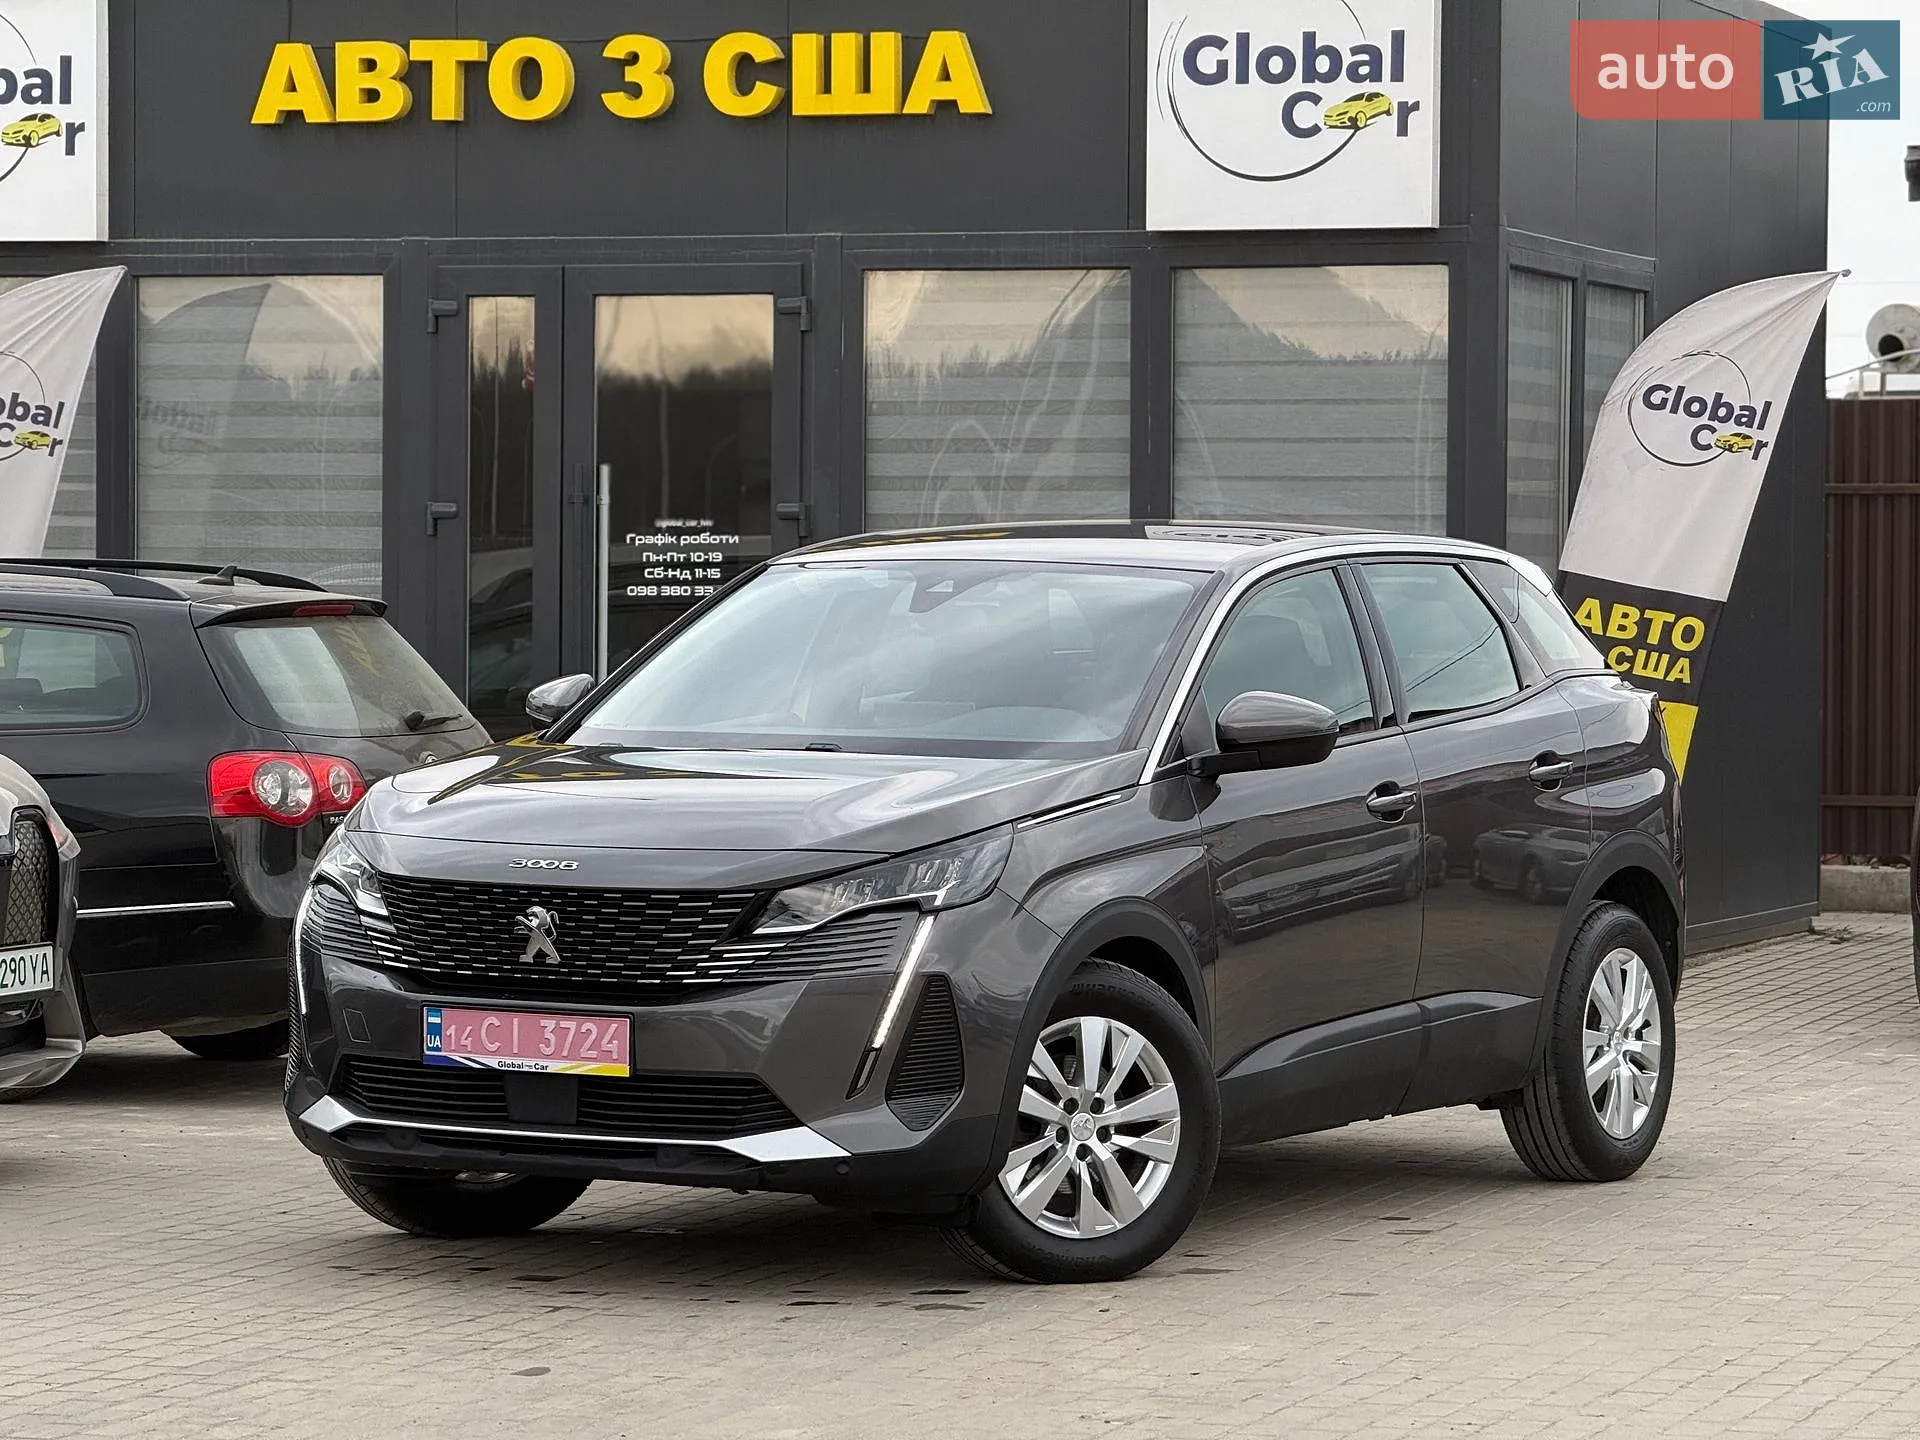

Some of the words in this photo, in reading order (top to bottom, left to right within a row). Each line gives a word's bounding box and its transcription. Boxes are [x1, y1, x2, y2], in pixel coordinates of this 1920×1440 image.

[1182, 30, 1405, 86] Global
[251, 37, 574, 125] АВТО
[704, 31, 994, 117] США
[0, 391, 65, 429] bal
[1642, 383, 1773, 431] Global
[626, 533, 677, 546] Графік
[680, 532, 739, 546] роботи
[642, 552, 687, 562] Пн-Пт
[690, 552, 722, 562] 10-19
[644, 567, 692, 580] Сб-Нд
[695, 569, 721, 578] 11-15
[627, 586, 657, 596] 098
[660, 586, 691, 596] 380
[1574, 597, 1705, 652] АВТО
[1607, 645, 1691, 684] США
[508, 858, 580, 870] 3008
[427, 1034, 441, 1048] UA
[539, 1019, 619, 1060] 3724
[497, 1060, 524, 1069] Global
[533, 1062, 549, 1071] Car
